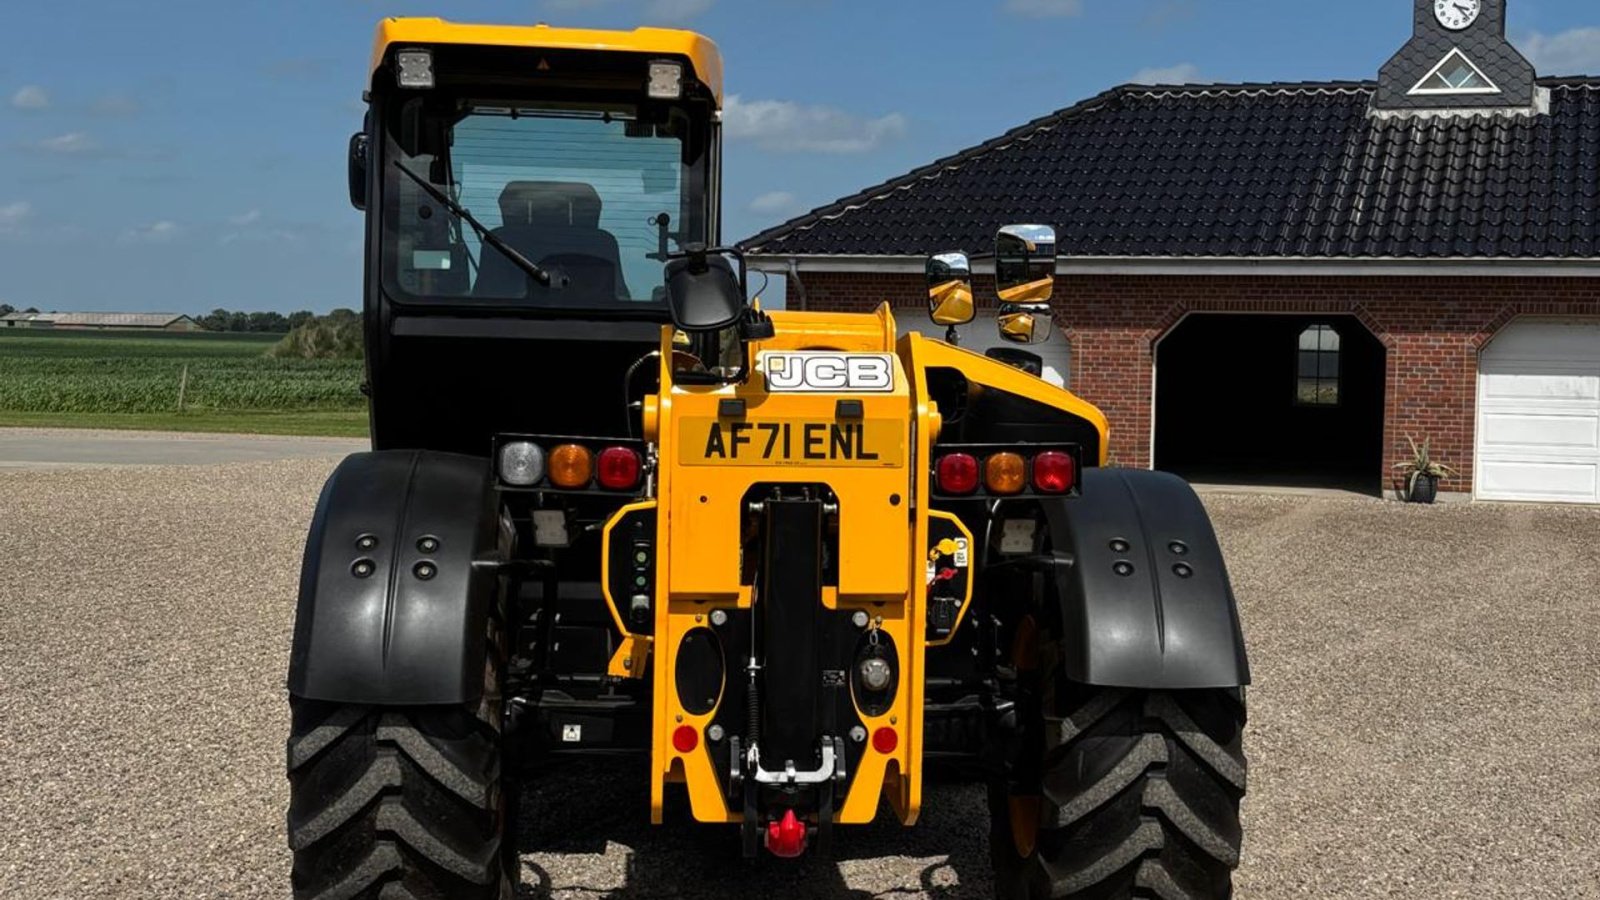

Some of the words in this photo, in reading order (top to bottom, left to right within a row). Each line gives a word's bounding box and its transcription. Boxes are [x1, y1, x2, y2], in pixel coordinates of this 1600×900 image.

[768, 356, 891, 388] JCB
[704, 422, 791, 459] AF71
[803, 423, 879, 460] ENL
